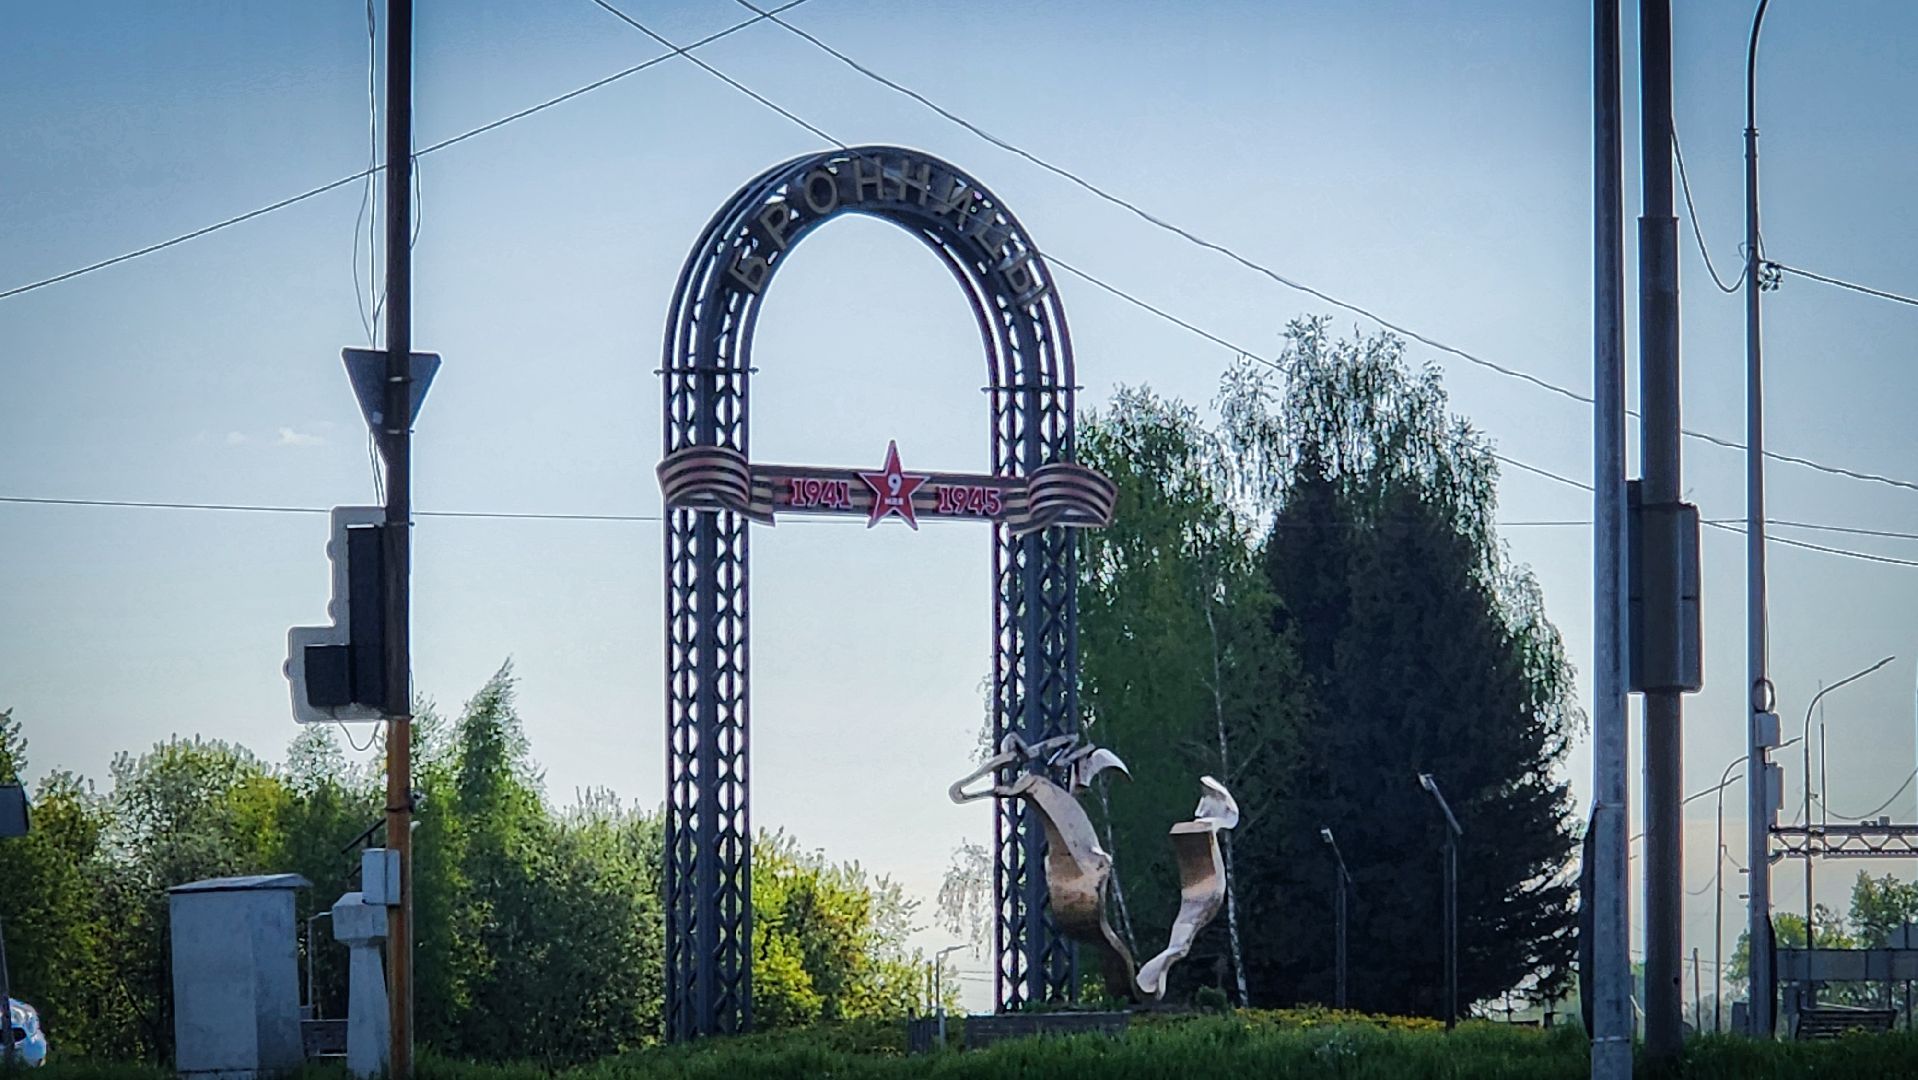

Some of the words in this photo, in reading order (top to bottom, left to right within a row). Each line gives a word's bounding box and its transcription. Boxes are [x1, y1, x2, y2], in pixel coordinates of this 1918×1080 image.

[728, 157, 1050, 307] БРОННИЦЫ
[790, 479, 852, 508] 1941
[887, 473, 902, 496] 9
[936, 486, 1002, 516] 1945
